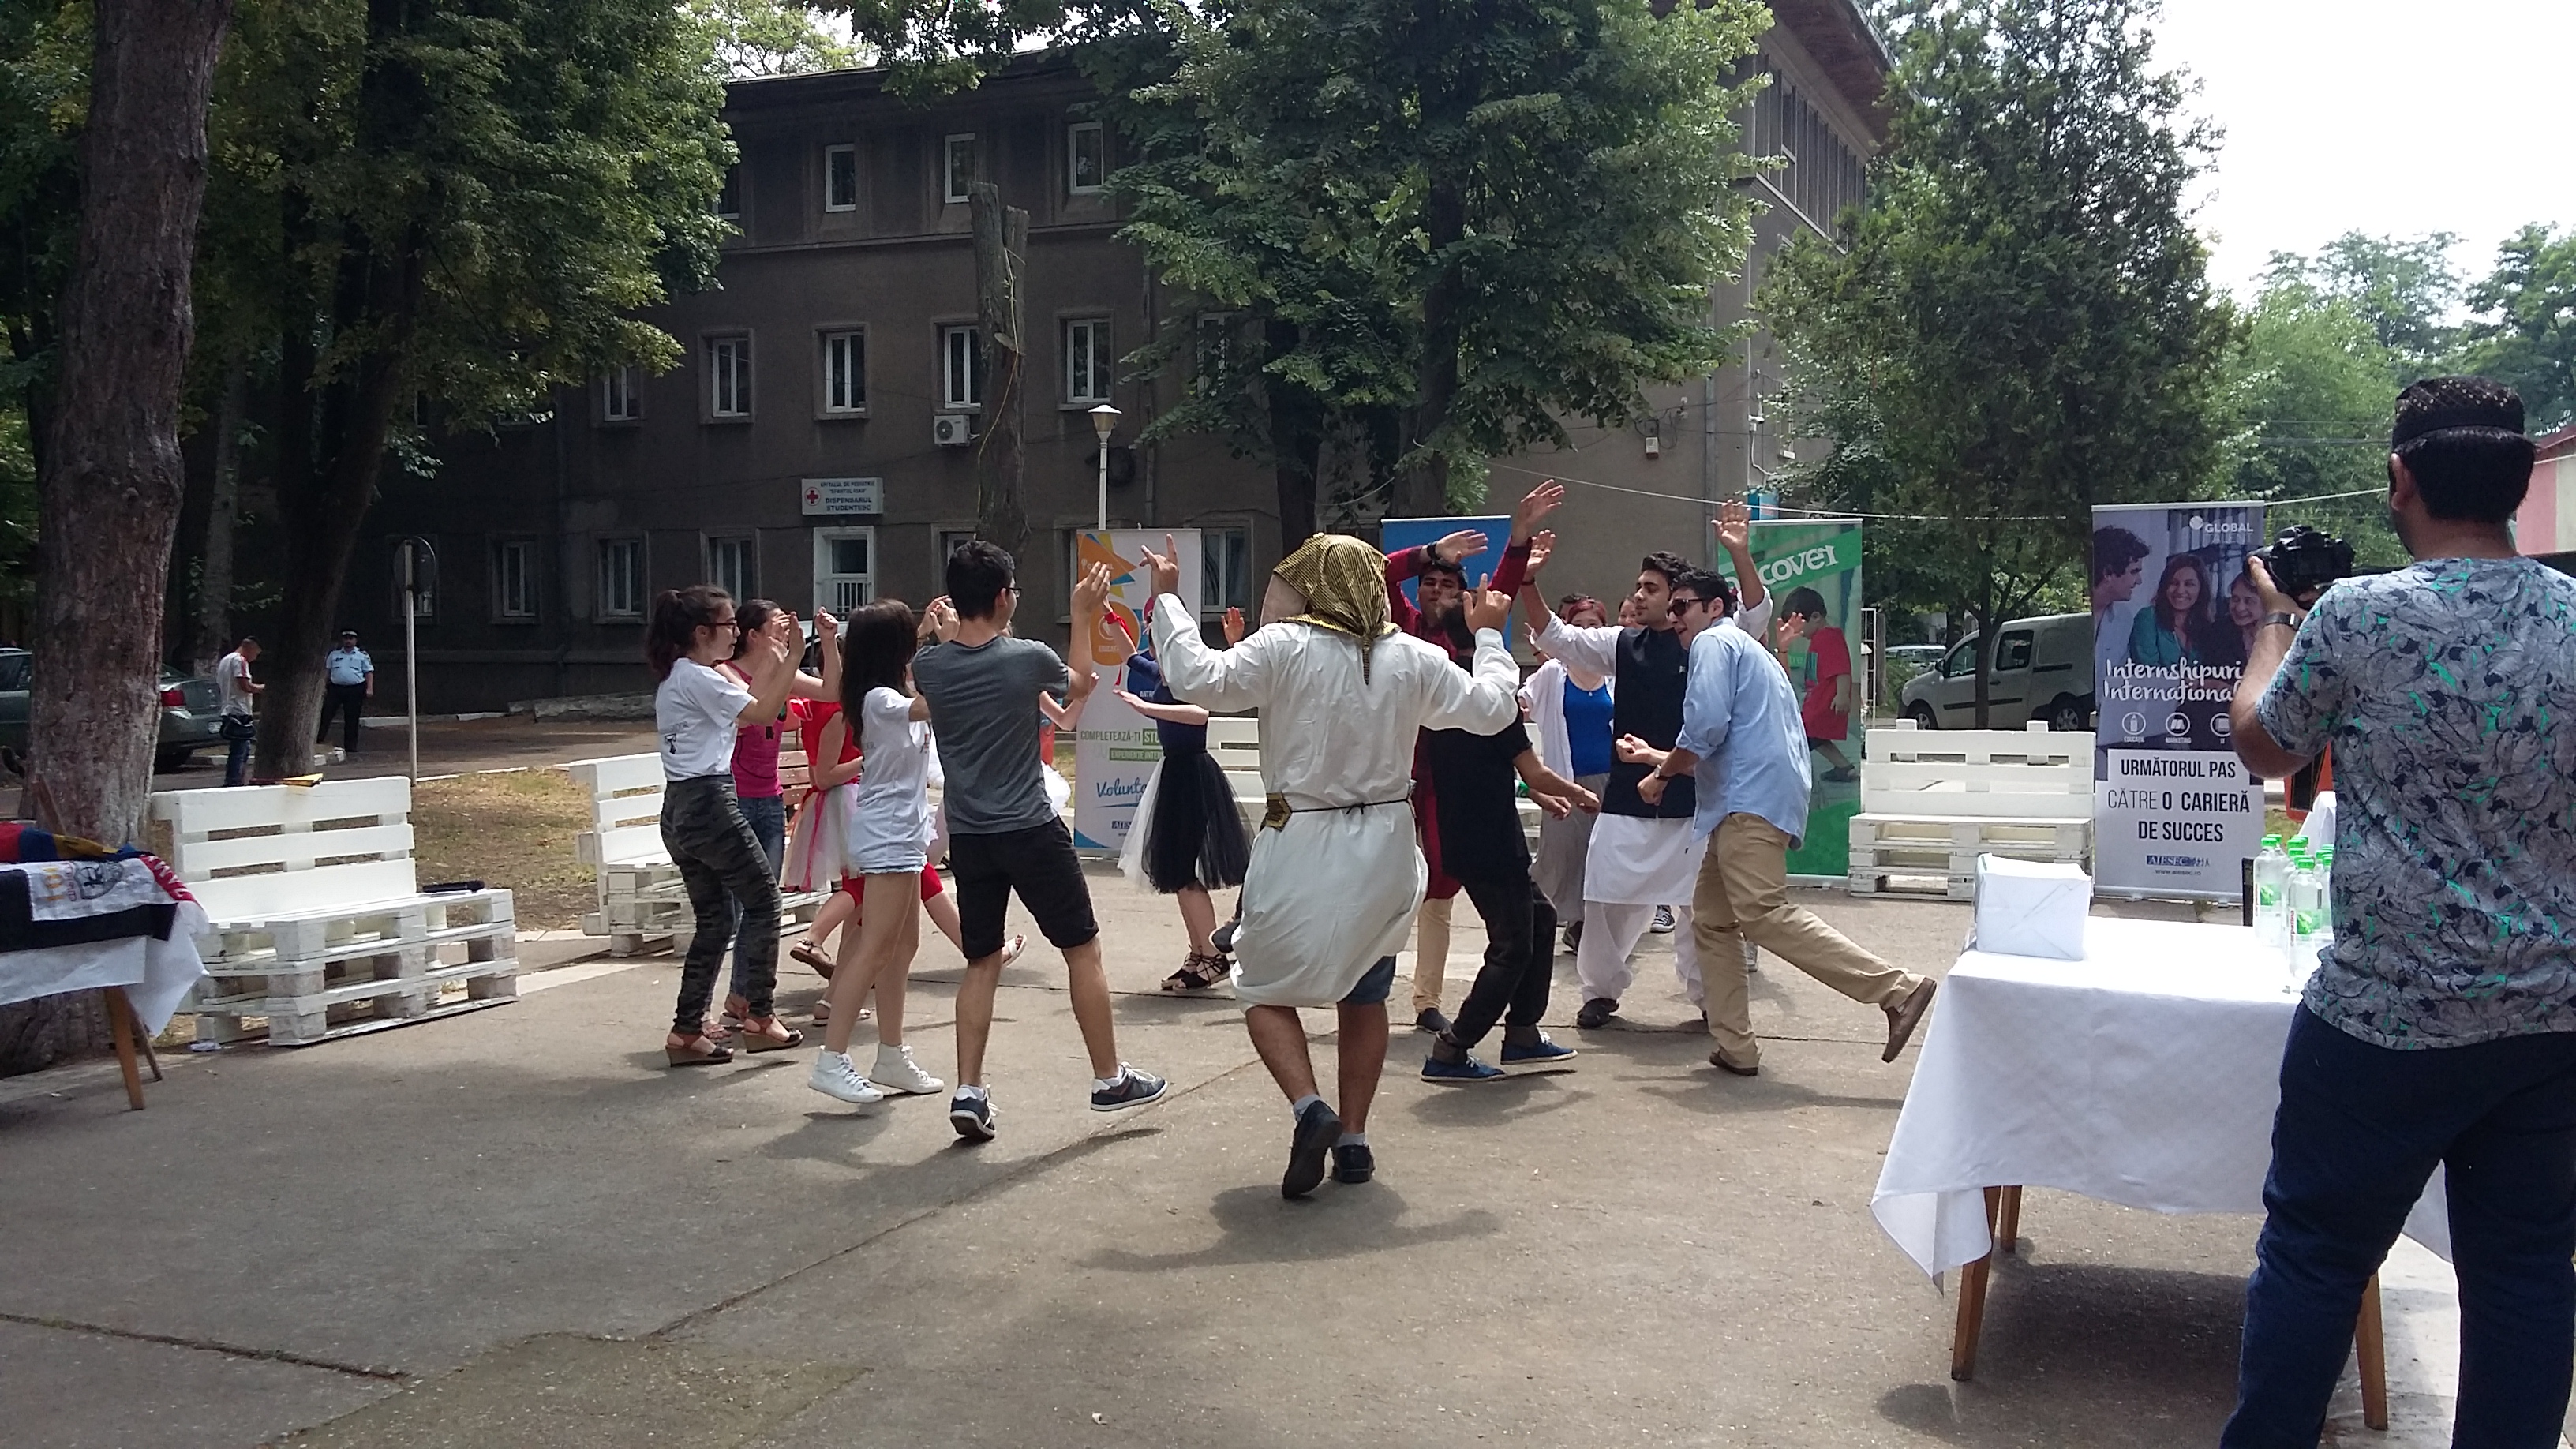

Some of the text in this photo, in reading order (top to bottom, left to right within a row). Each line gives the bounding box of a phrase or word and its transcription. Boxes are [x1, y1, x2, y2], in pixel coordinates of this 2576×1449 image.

[2205, 522, 2254, 533] GLOBAL
[2106, 657, 2243, 684] Internshipuri
[2121, 757, 2236, 778] URMĂTORUL PAS
[1096, 777, 1148, 798] Volunta
[2107, 788, 2250, 813] CĂTRE O CARIERĂ
[2138, 821, 2223, 842] DE SUCCES
[2147, 856, 2187, 866] AIESEC
